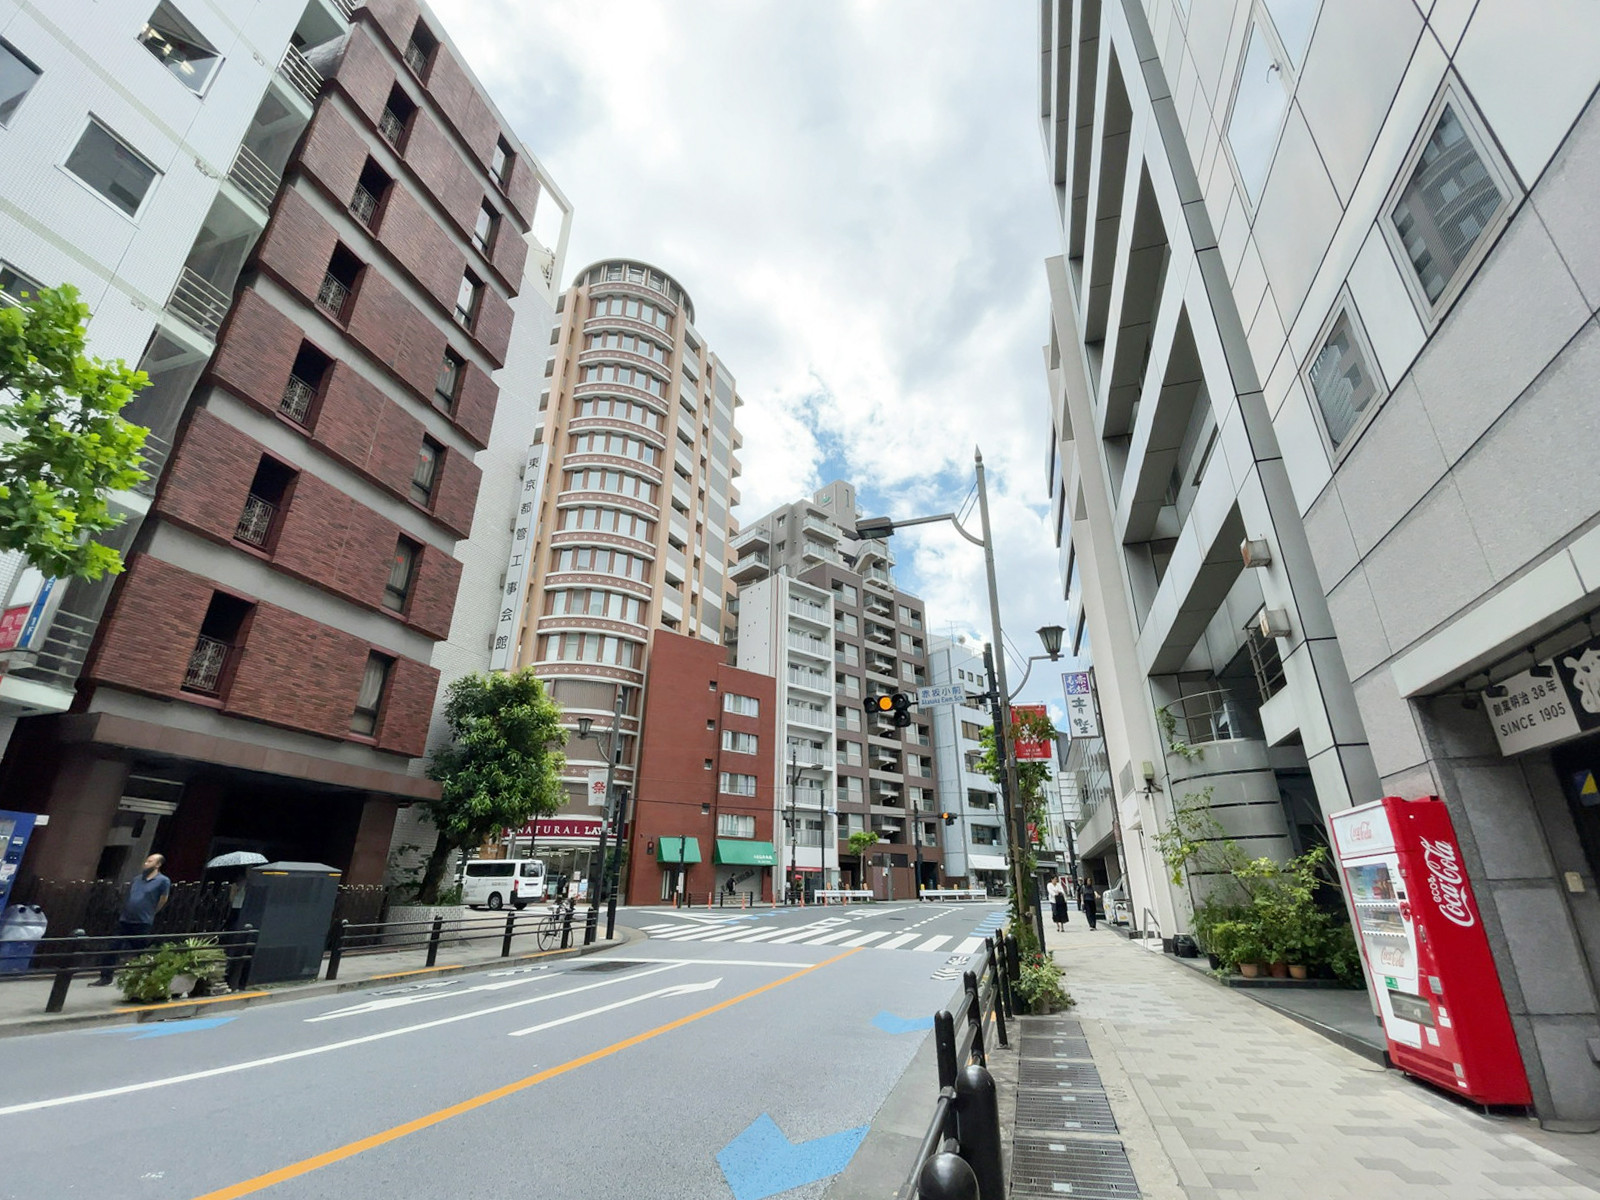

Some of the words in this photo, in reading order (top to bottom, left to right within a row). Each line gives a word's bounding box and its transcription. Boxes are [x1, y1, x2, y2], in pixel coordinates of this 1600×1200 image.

[495, 457, 540, 650] 東京都管工事会館
[1500, 713, 1537, 737] SINCE
[1539, 701, 1566, 722] 1905
[517, 824, 581, 835] NATURAL
